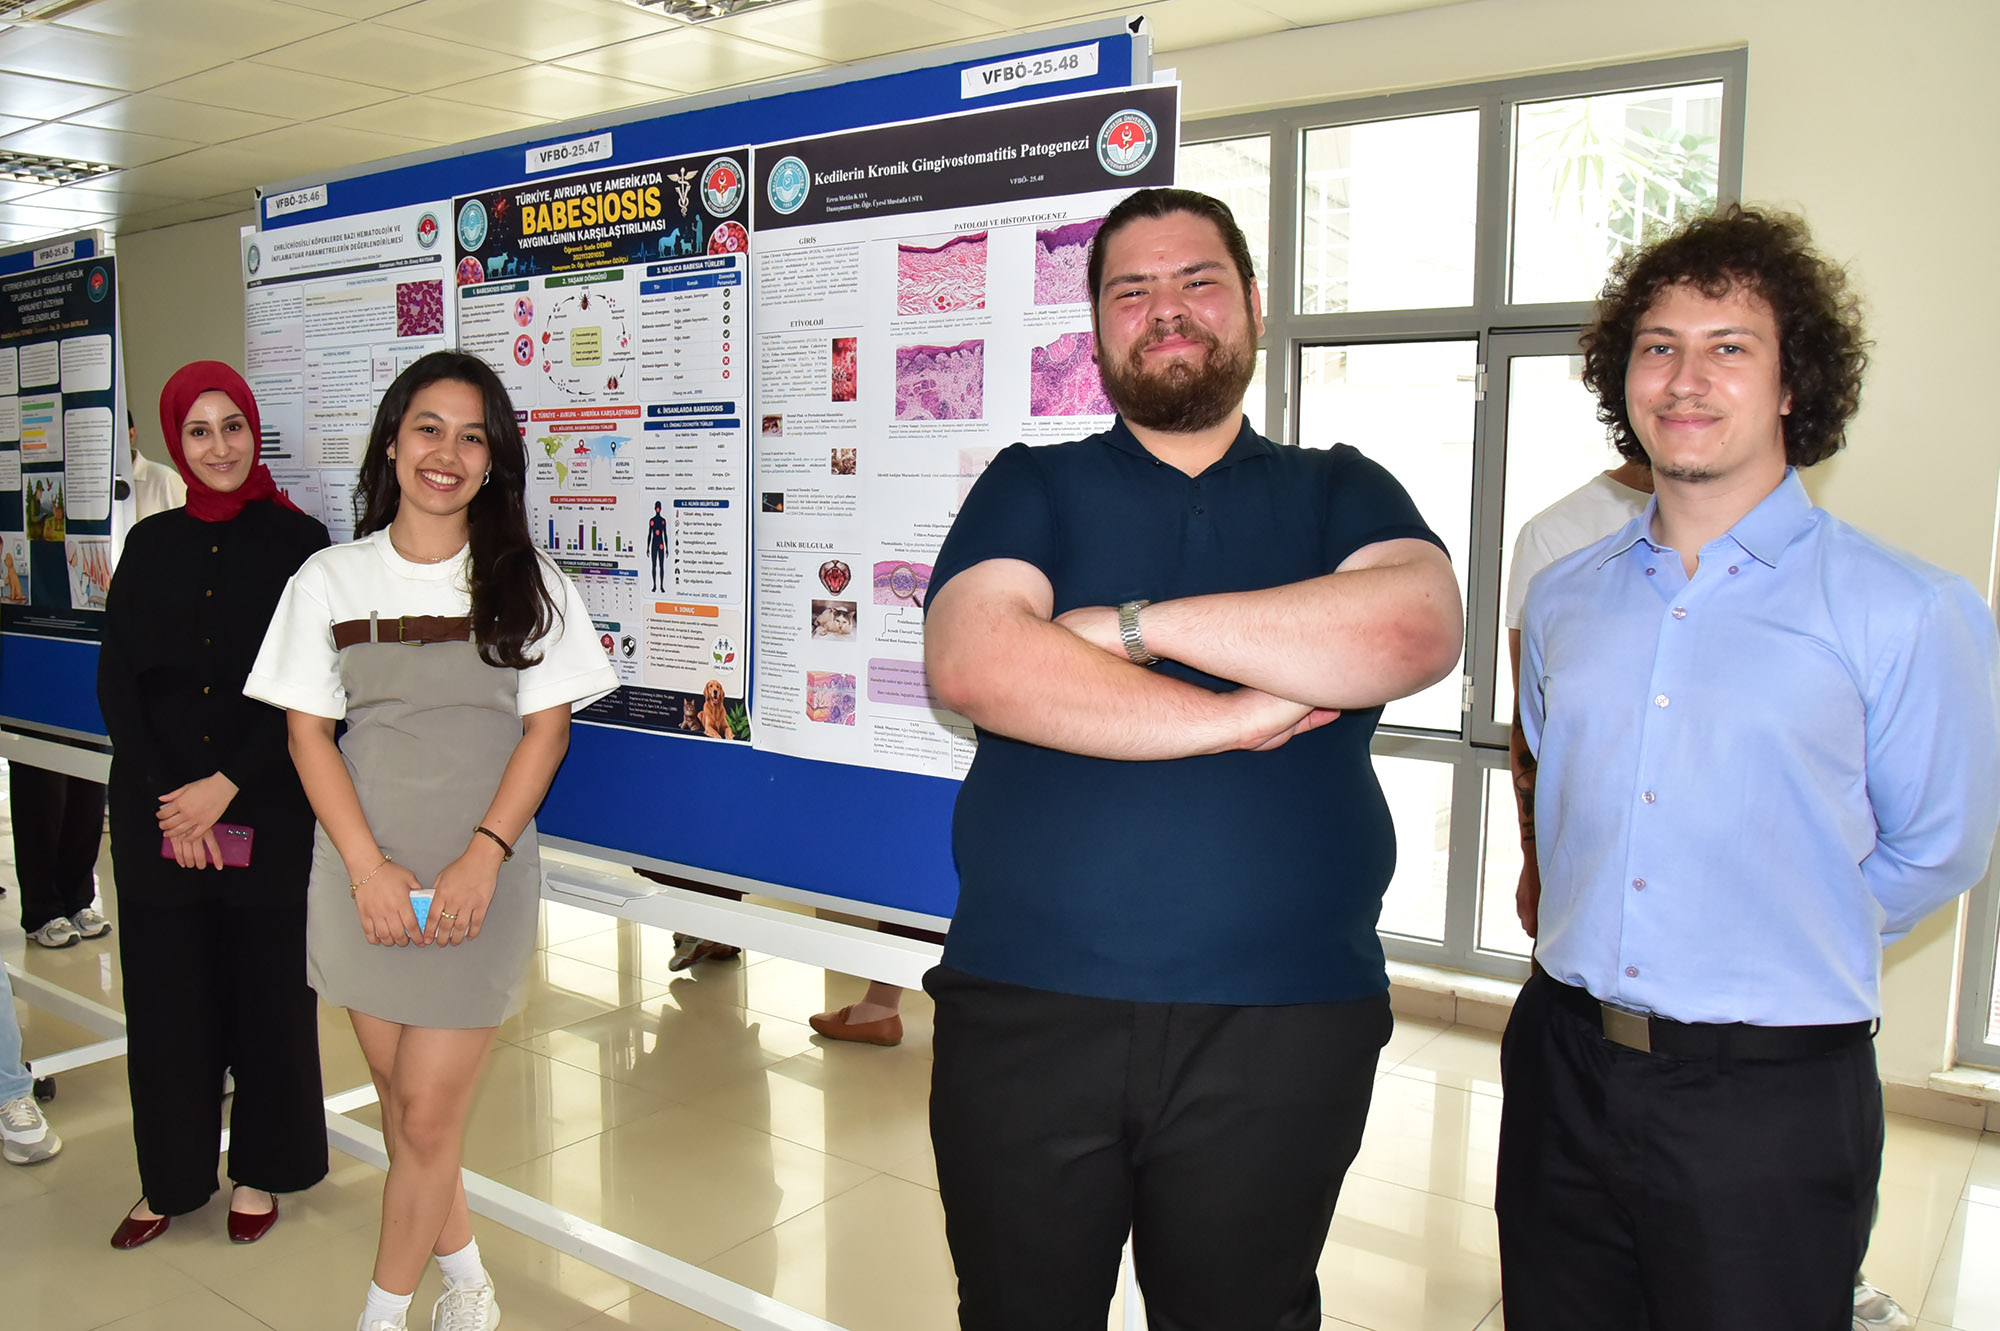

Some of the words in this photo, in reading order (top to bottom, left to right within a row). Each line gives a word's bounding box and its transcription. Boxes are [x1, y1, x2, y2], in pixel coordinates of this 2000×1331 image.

[982, 54, 1079, 85] VFBÖ-25.48
[540, 144, 601, 164] VFBÖ-25.47
[814, 167, 865, 185] Kedilerin
[867, 159, 910, 179] Kronik
[911, 145, 1017, 174] Gingivostomatitis
[1020, 135, 1090, 158] Patogenezi
[515, 189, 552, 206] TÜRKİYE,
[553, 184, 588, 200] AVRUPA
[589, 181, 602, 193] VE
[604, 172, 663, 191] AMERİKA'DA
[275, 191, 320, 209] VFBÖ-25.46
[521, 186, 662, 235] BABESIOSIS
[954, 219, 988, 230] PATOLOJİ
[989, 218, 999, 226] VE
[1000, 211, 1067, 225] HİSTOPATOGENEZ
[311, 234, 343, 245] KÖPEKLERDE
[343, 232, 356, 241] BAZI
[356, 225, 393, 238] HEMATOLOJİK
[517, 230, 576, 249] YAYGINLIĞININ
[577, 219, 666, 241] KARŞILAŞTIRILMASI
[798, 237, 817, 246] GİRİŞ
[39, 246, 69, 261] VFBÖ-25.45
[271, 251, 305, 263] İNFLAMATUAR
[305, 244, 350, 257] PARAMETRELERİN
[350, 234, 404, 251] DEĞERLENDİRİLMESİ
[662, 264, 682, 274] BAŞLICA
[683, 262, 704, 271] BABESIA
[790, 317, 824, 328] ETİYOLOJİ
